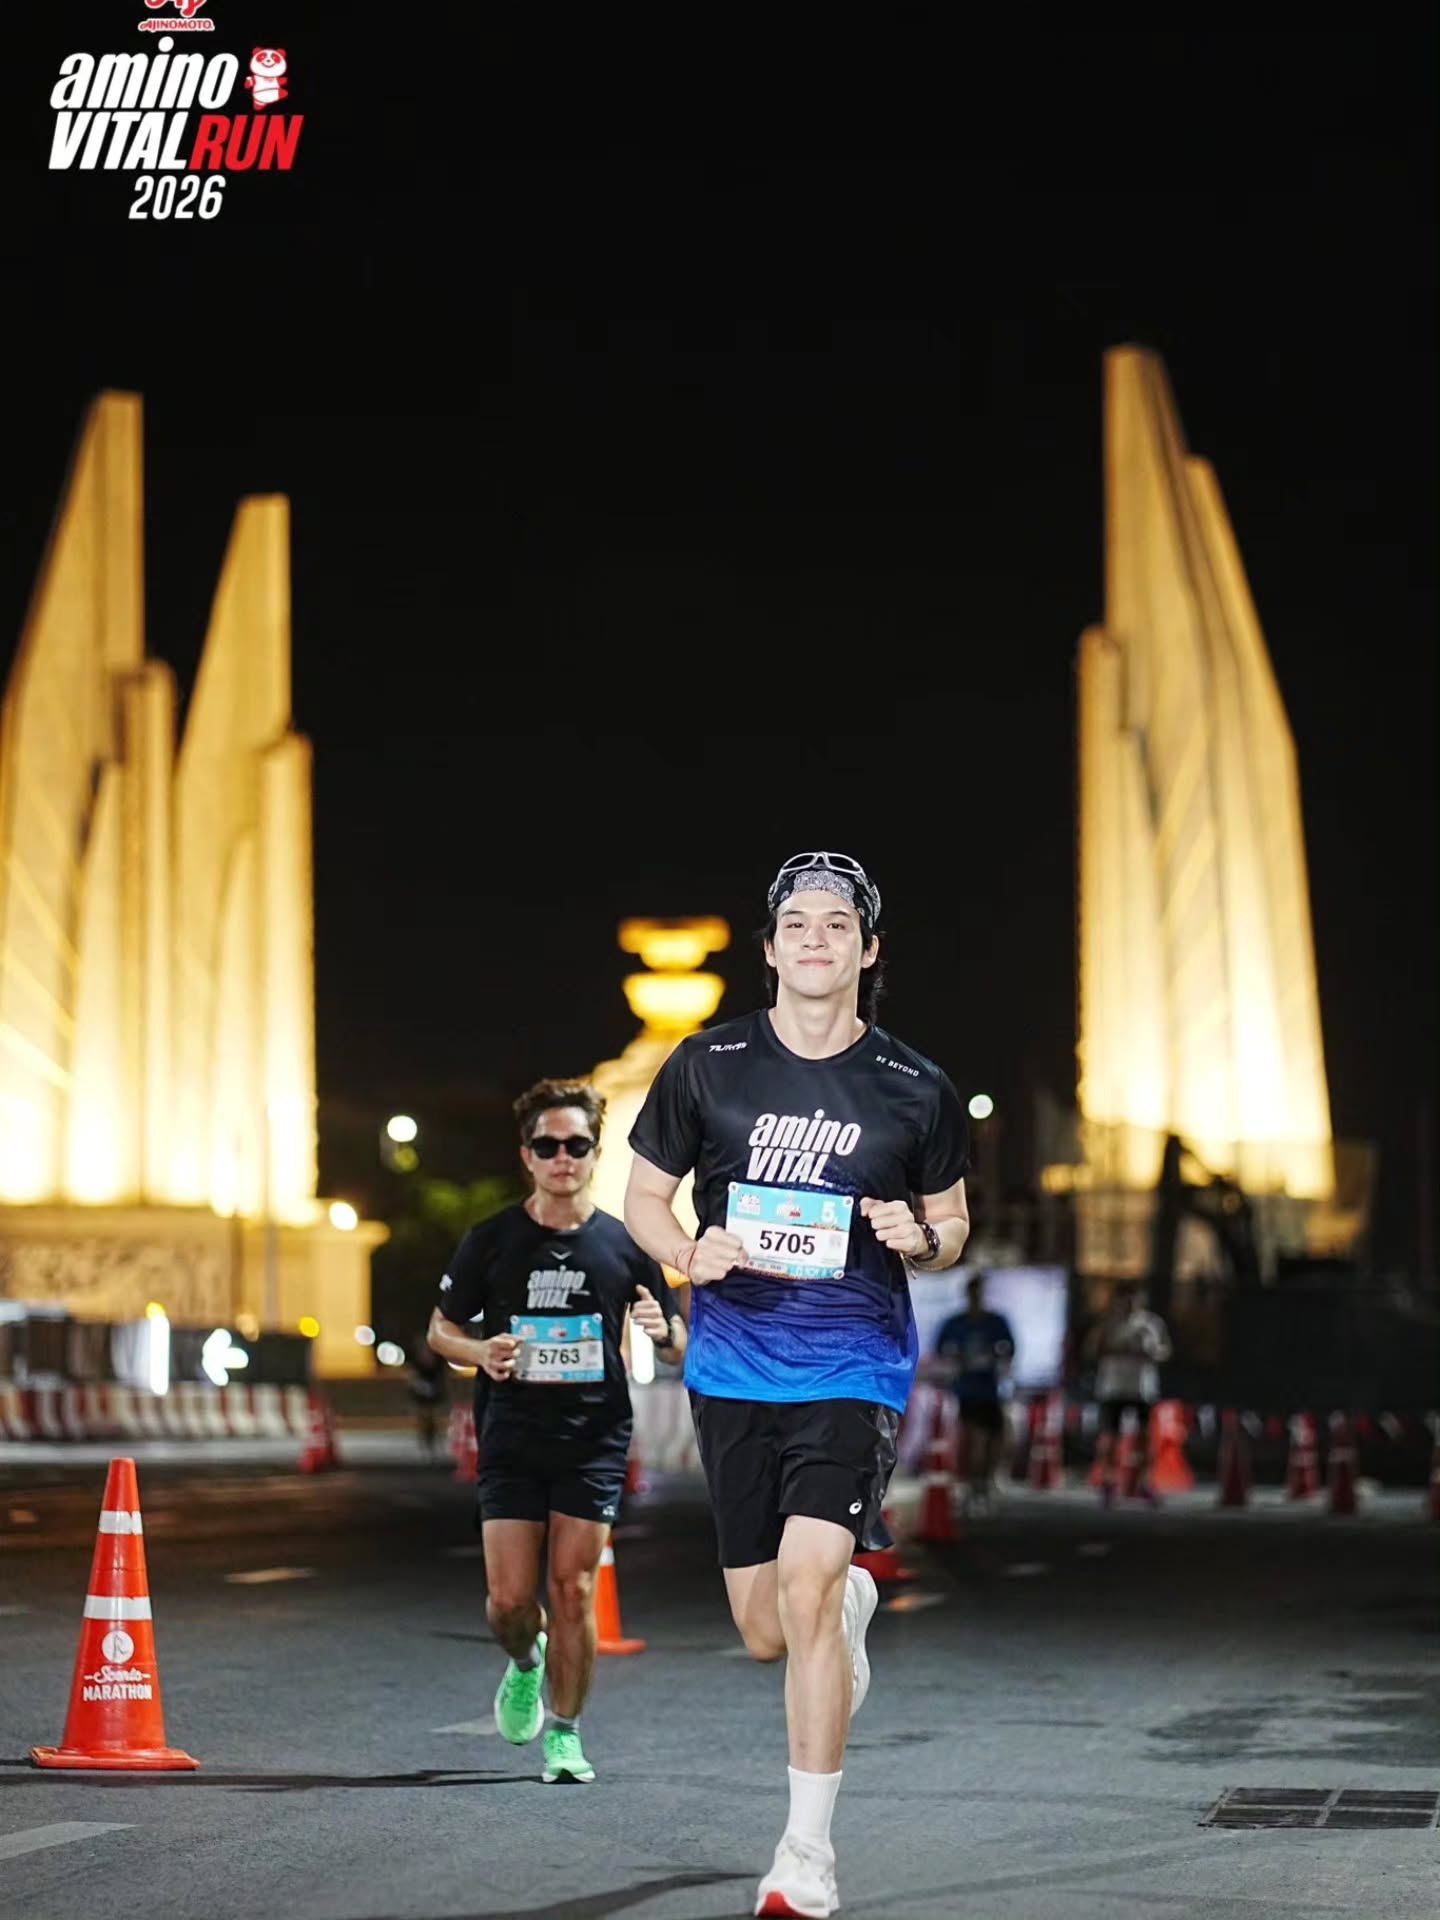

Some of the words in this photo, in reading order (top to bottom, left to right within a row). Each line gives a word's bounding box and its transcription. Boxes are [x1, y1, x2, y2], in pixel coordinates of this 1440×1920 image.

[875, 1055, 887, 1064] BE
[888, 1060, 919, 1077] BEYOND
[748, 1108, 861, 1156] amino
[746, 1146, 829, 1186] VITAL
[759, 1230, 815, 1255] 5705
[527, 1264, 586, 1290] amino
[527, 1289, 573, 1309] VITAL
[538, 1347, 580, 1365] 5763
[83, 1684, 152, 1702] MARATHON
